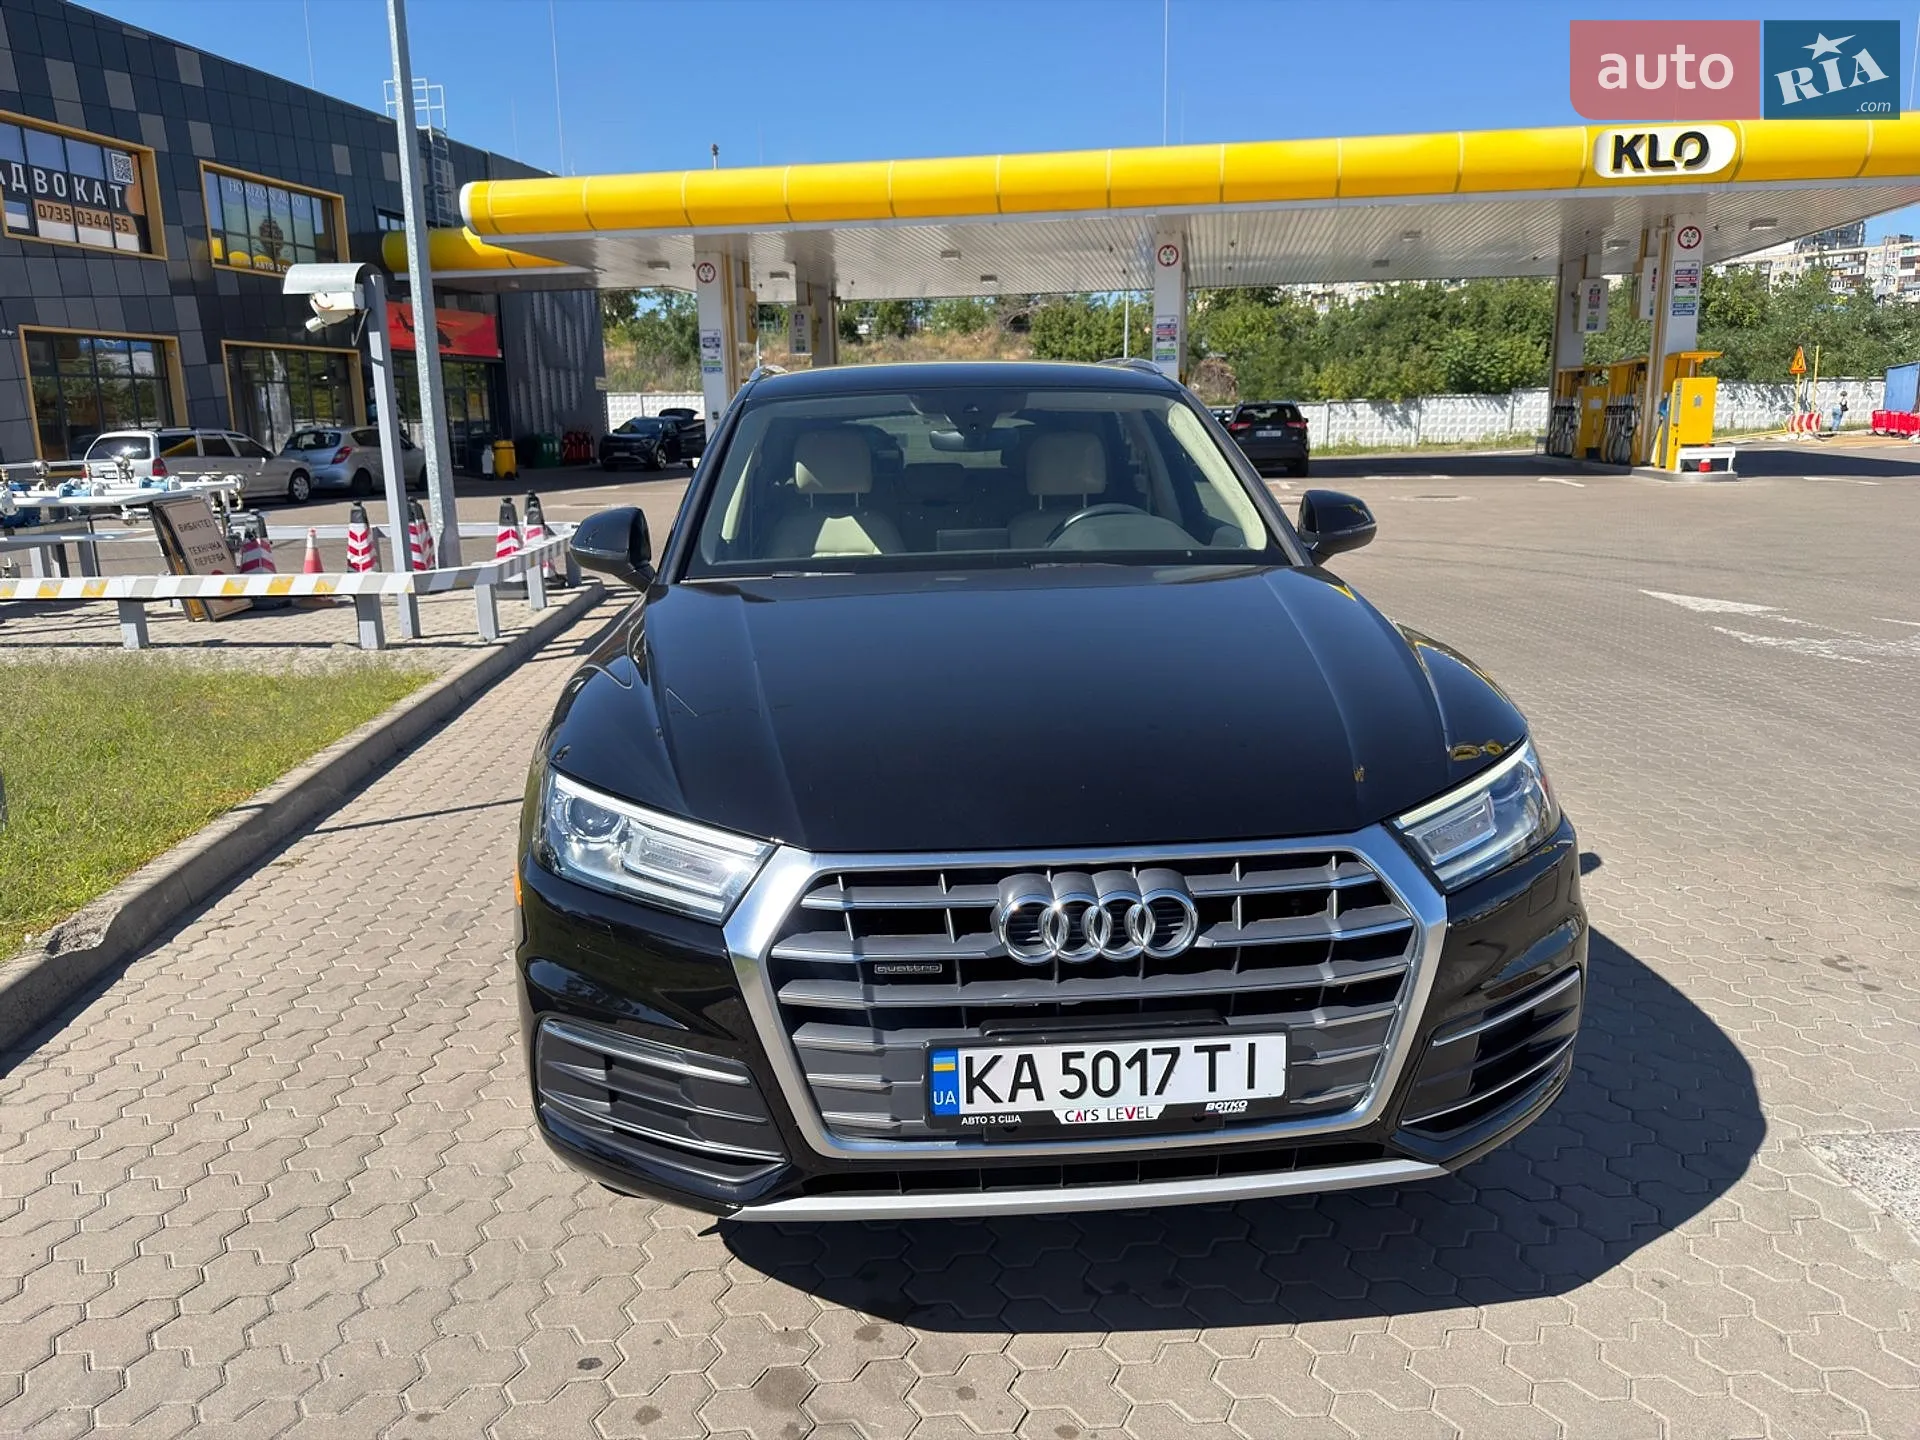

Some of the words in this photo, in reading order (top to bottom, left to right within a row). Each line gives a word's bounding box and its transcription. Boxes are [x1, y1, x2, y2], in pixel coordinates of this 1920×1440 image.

[1612, 131, 1710, 171] KLO
[877, 964, 939, 974] quattro
[965, 1054, 1044, 1104] KA
[1059, 1046, 1181, 1100] 5017
[1194, 1043, 1256, 1093] TI
[933, 1091, 956, 1105] UA
[1206, 1100, 1248, 1111] BOYKO
[961, 1116, 987, 1125] АВТО
[998, 1114, 1022, 1124] США
[1107, 1107, 1154, 1121] LEVEL
